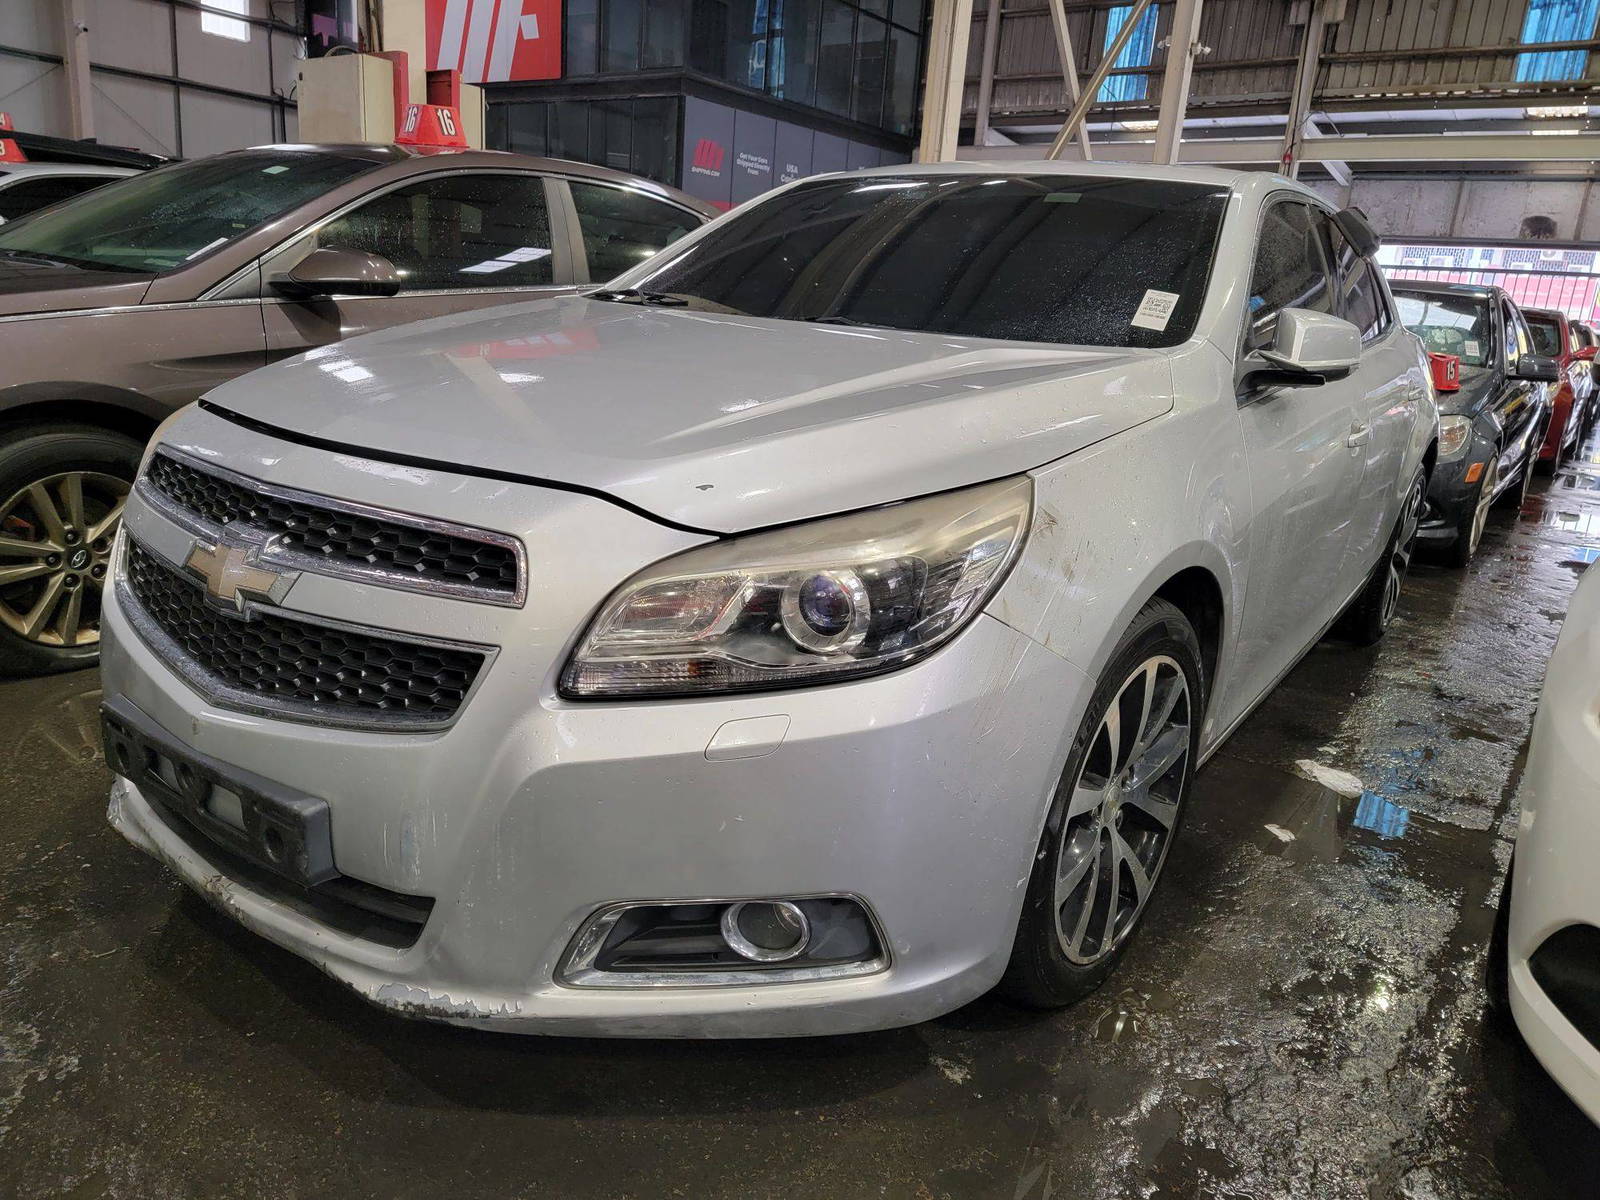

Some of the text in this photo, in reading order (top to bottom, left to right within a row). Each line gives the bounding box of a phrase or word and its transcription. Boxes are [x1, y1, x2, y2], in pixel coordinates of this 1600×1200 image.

[405, 106, 418, 132] 16
[437, 108, 456, 136] 16
[786, 163, 798, 174] USA
[1447, 360, 1455, 381] 15
